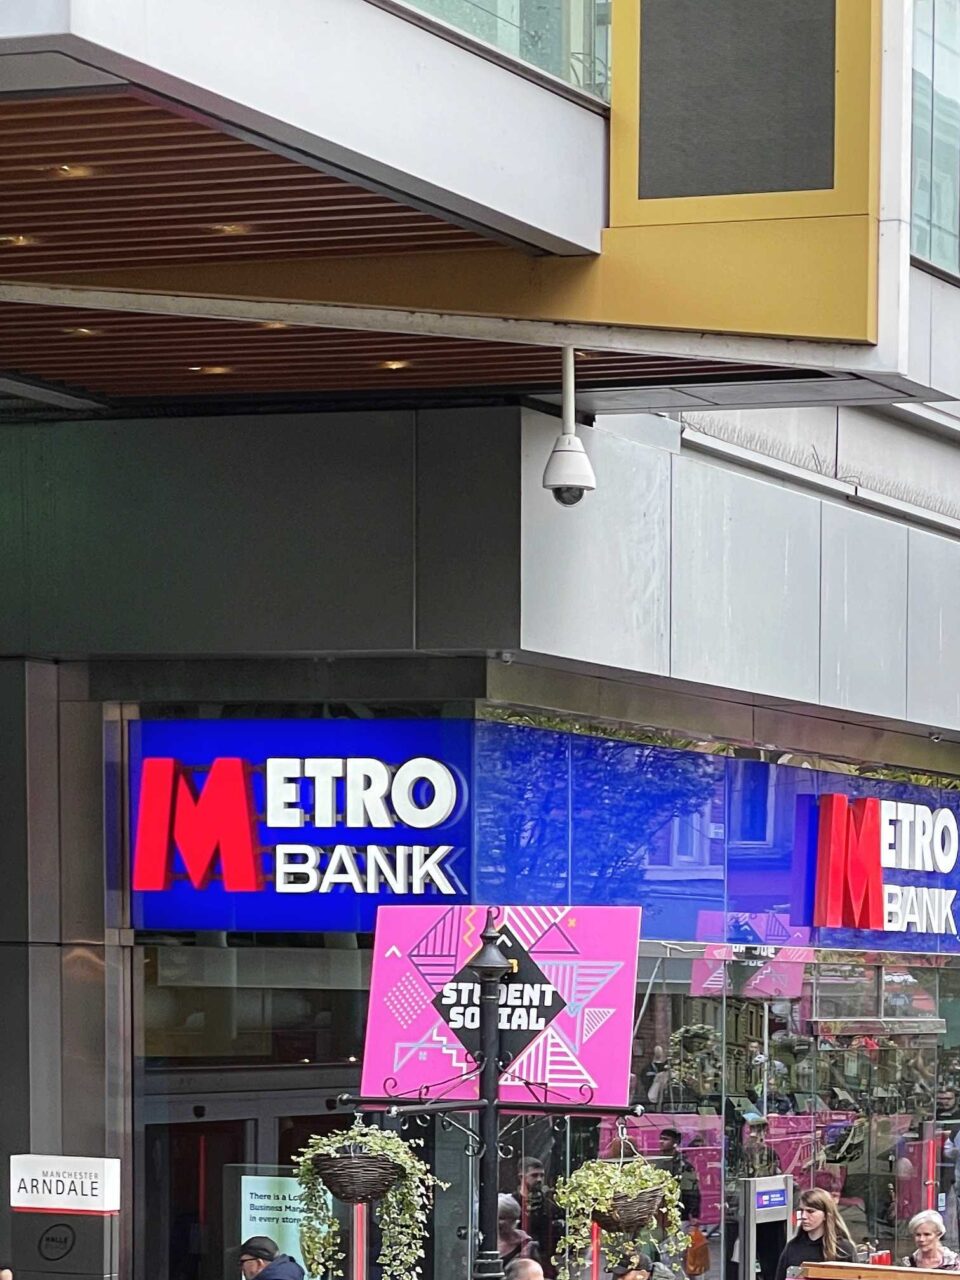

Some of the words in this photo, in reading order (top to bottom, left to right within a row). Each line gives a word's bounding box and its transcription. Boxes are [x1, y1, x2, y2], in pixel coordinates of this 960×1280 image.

[133, 757, 457, 892] METRO
[275, 844, 460, 896] BANK
[813, 793, 959, 931] METRO
[883, 885, 959, 935] BANK
[448, 1006, 546, 1031] SOIAL
[17, 1178, 99, 1197] ARNDALE
[42, 1169, 99, 1181] MANCHESTER
[249, 1192, 271, 1200] There
[273, 1192, 280, 1200] is
[249, 1203, 283, 1212] Business
